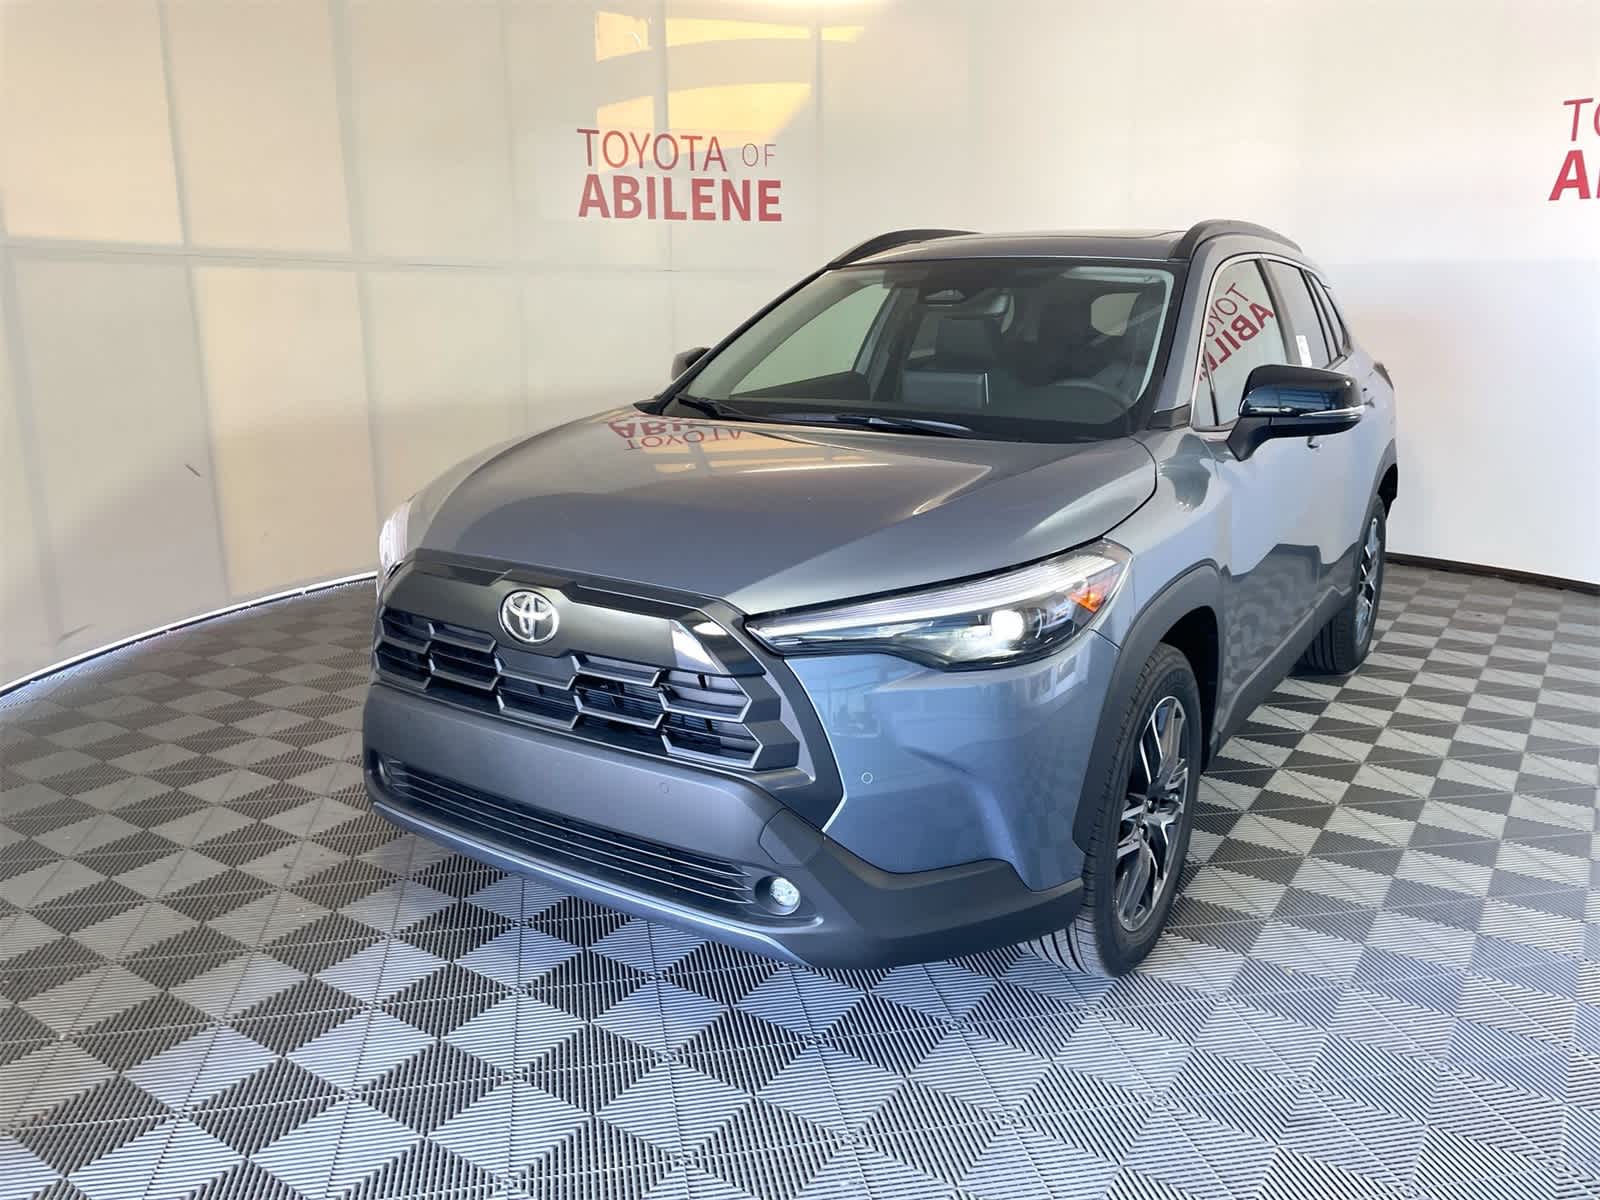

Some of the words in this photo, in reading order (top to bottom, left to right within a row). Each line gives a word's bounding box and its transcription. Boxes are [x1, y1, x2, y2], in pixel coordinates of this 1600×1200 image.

[1563, 98, 1600, 142] T
[577, 128, 727, 172] TOYOTA
[742, 143, 777, 167] OF
[578, 174, 782, 221] ABILENE
[1548, 149, 1600, 201] A
